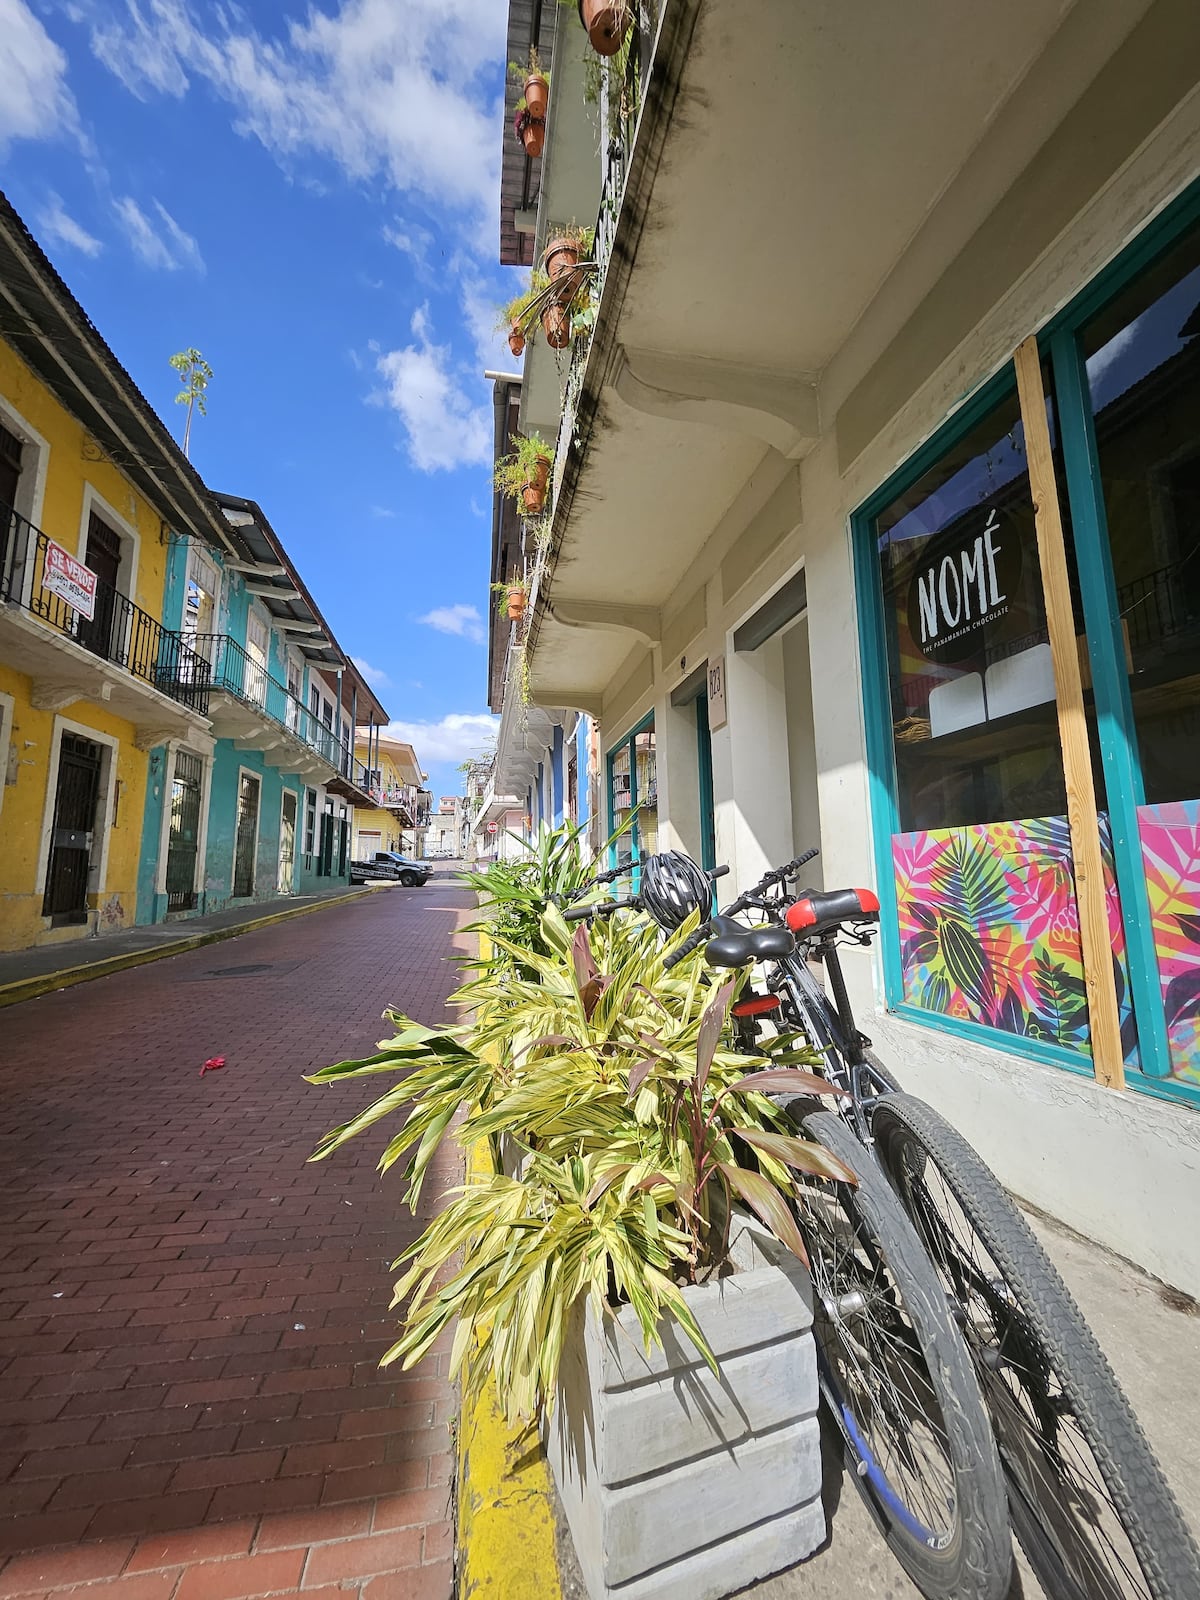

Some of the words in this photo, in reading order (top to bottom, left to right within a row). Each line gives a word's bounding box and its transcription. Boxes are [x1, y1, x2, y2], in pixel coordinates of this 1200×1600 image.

[51, 548, 64, 571] SE
[66, 558, 94, 592] VENDE
[918, 508, 1007, 643] NOMÉ
[923, 644, 933, 654] THE
[933, 625, 971, 649] PANAMANIAN
[972, 605, 1009, 630] CHOCOLATE
